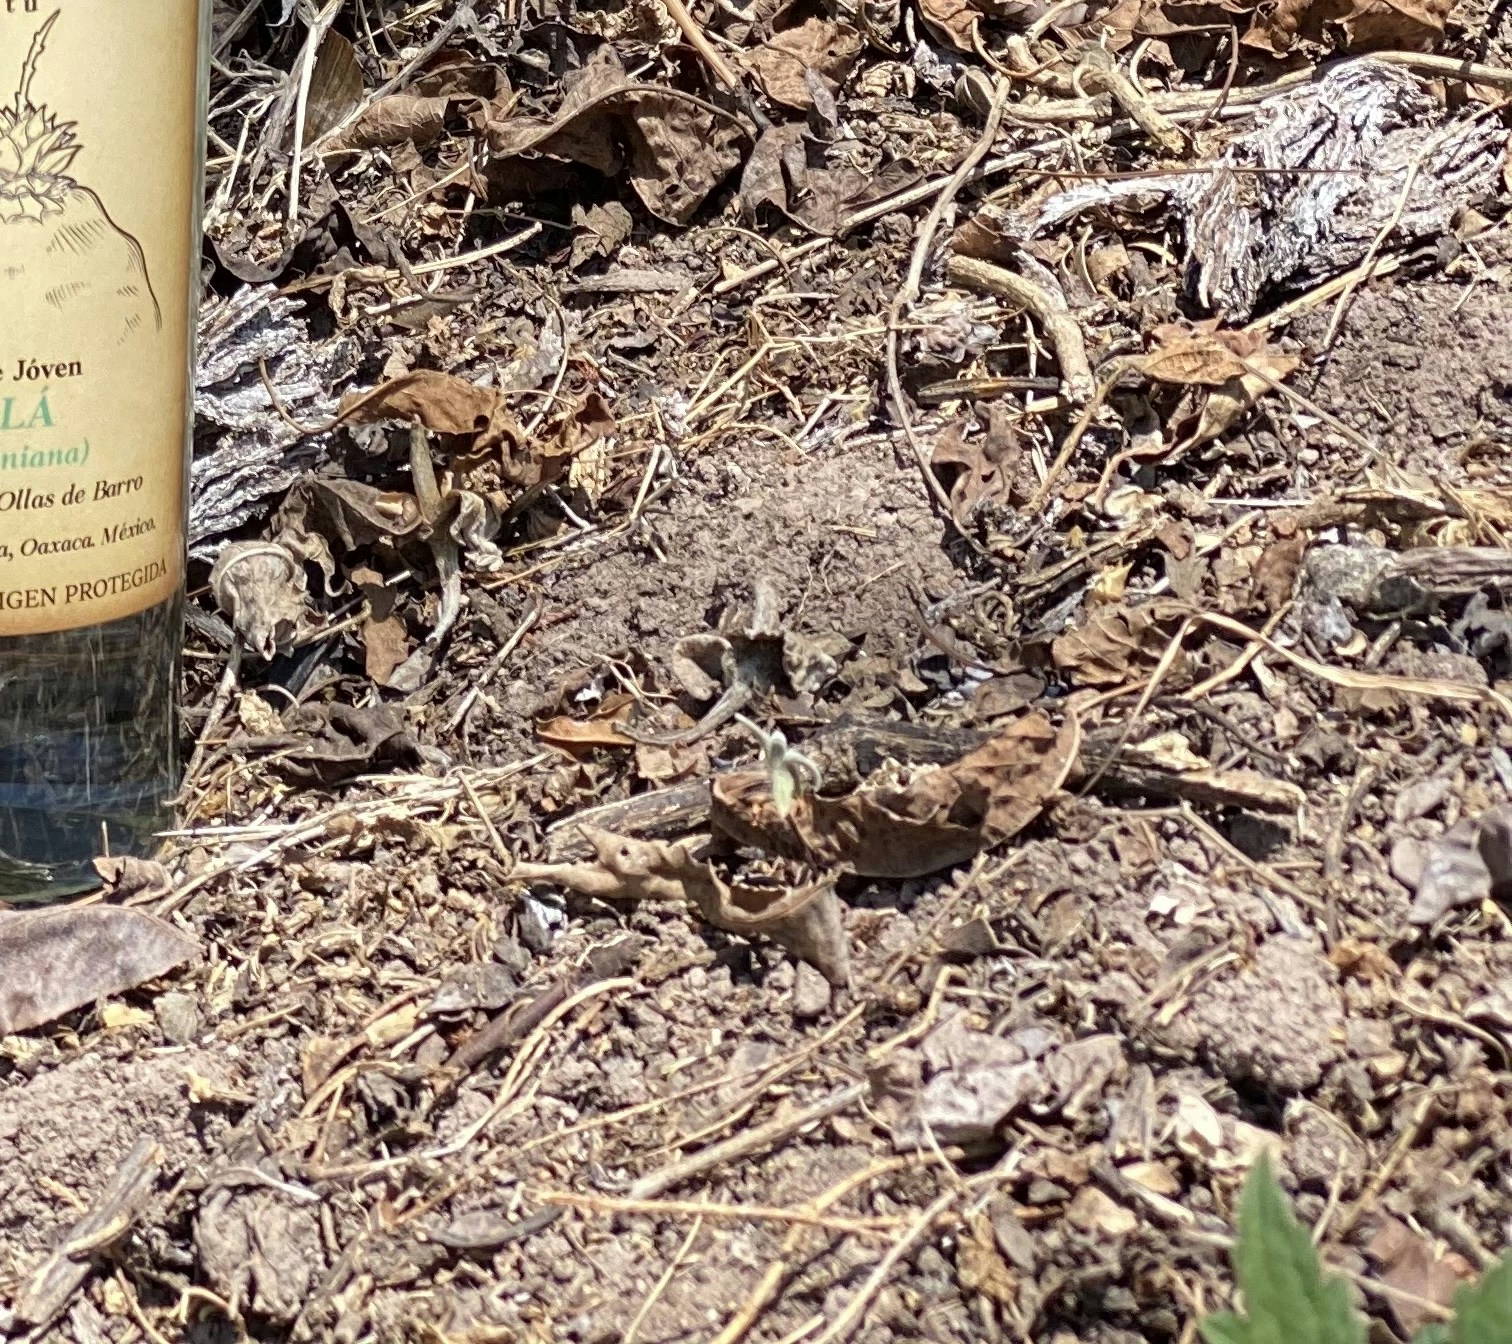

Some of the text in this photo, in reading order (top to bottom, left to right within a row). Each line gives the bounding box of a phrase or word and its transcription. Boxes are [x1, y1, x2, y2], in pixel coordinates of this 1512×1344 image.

[12, 358, 83, 382] Jóven
[61, 484, 86, 507] de
[91, 473, 144, 503] Barro
[64, 557, 168, 604] PROTEGIDA
